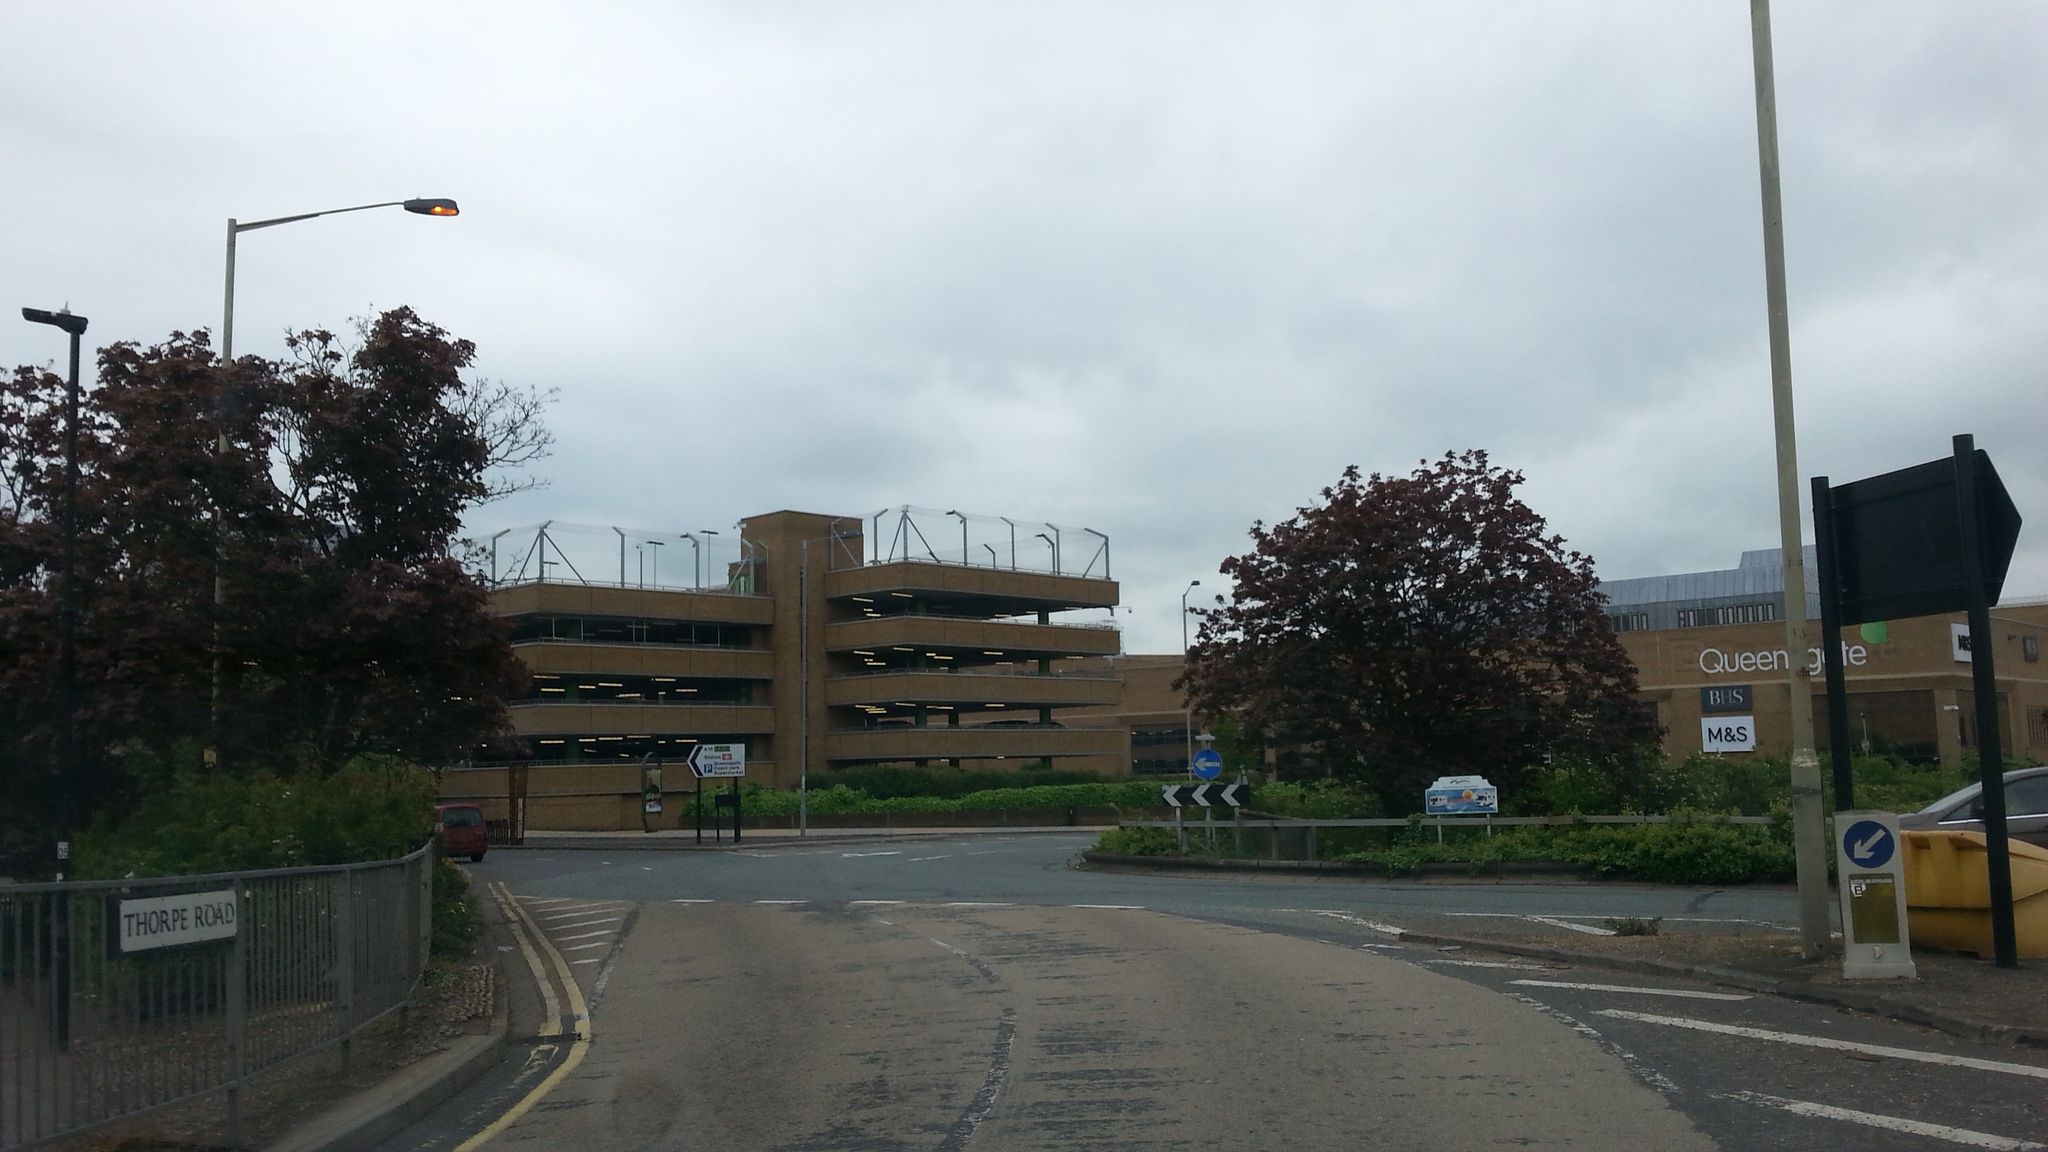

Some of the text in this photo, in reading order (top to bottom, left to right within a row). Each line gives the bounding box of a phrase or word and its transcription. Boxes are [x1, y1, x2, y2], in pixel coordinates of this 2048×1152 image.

[1700, 641, 1867, 676] Queengte
[1709, 688, 1744, 706] BHS
[1707, 726, 1748, 743] M&S
[124, 902, 235, 937] THORPE ROAD
